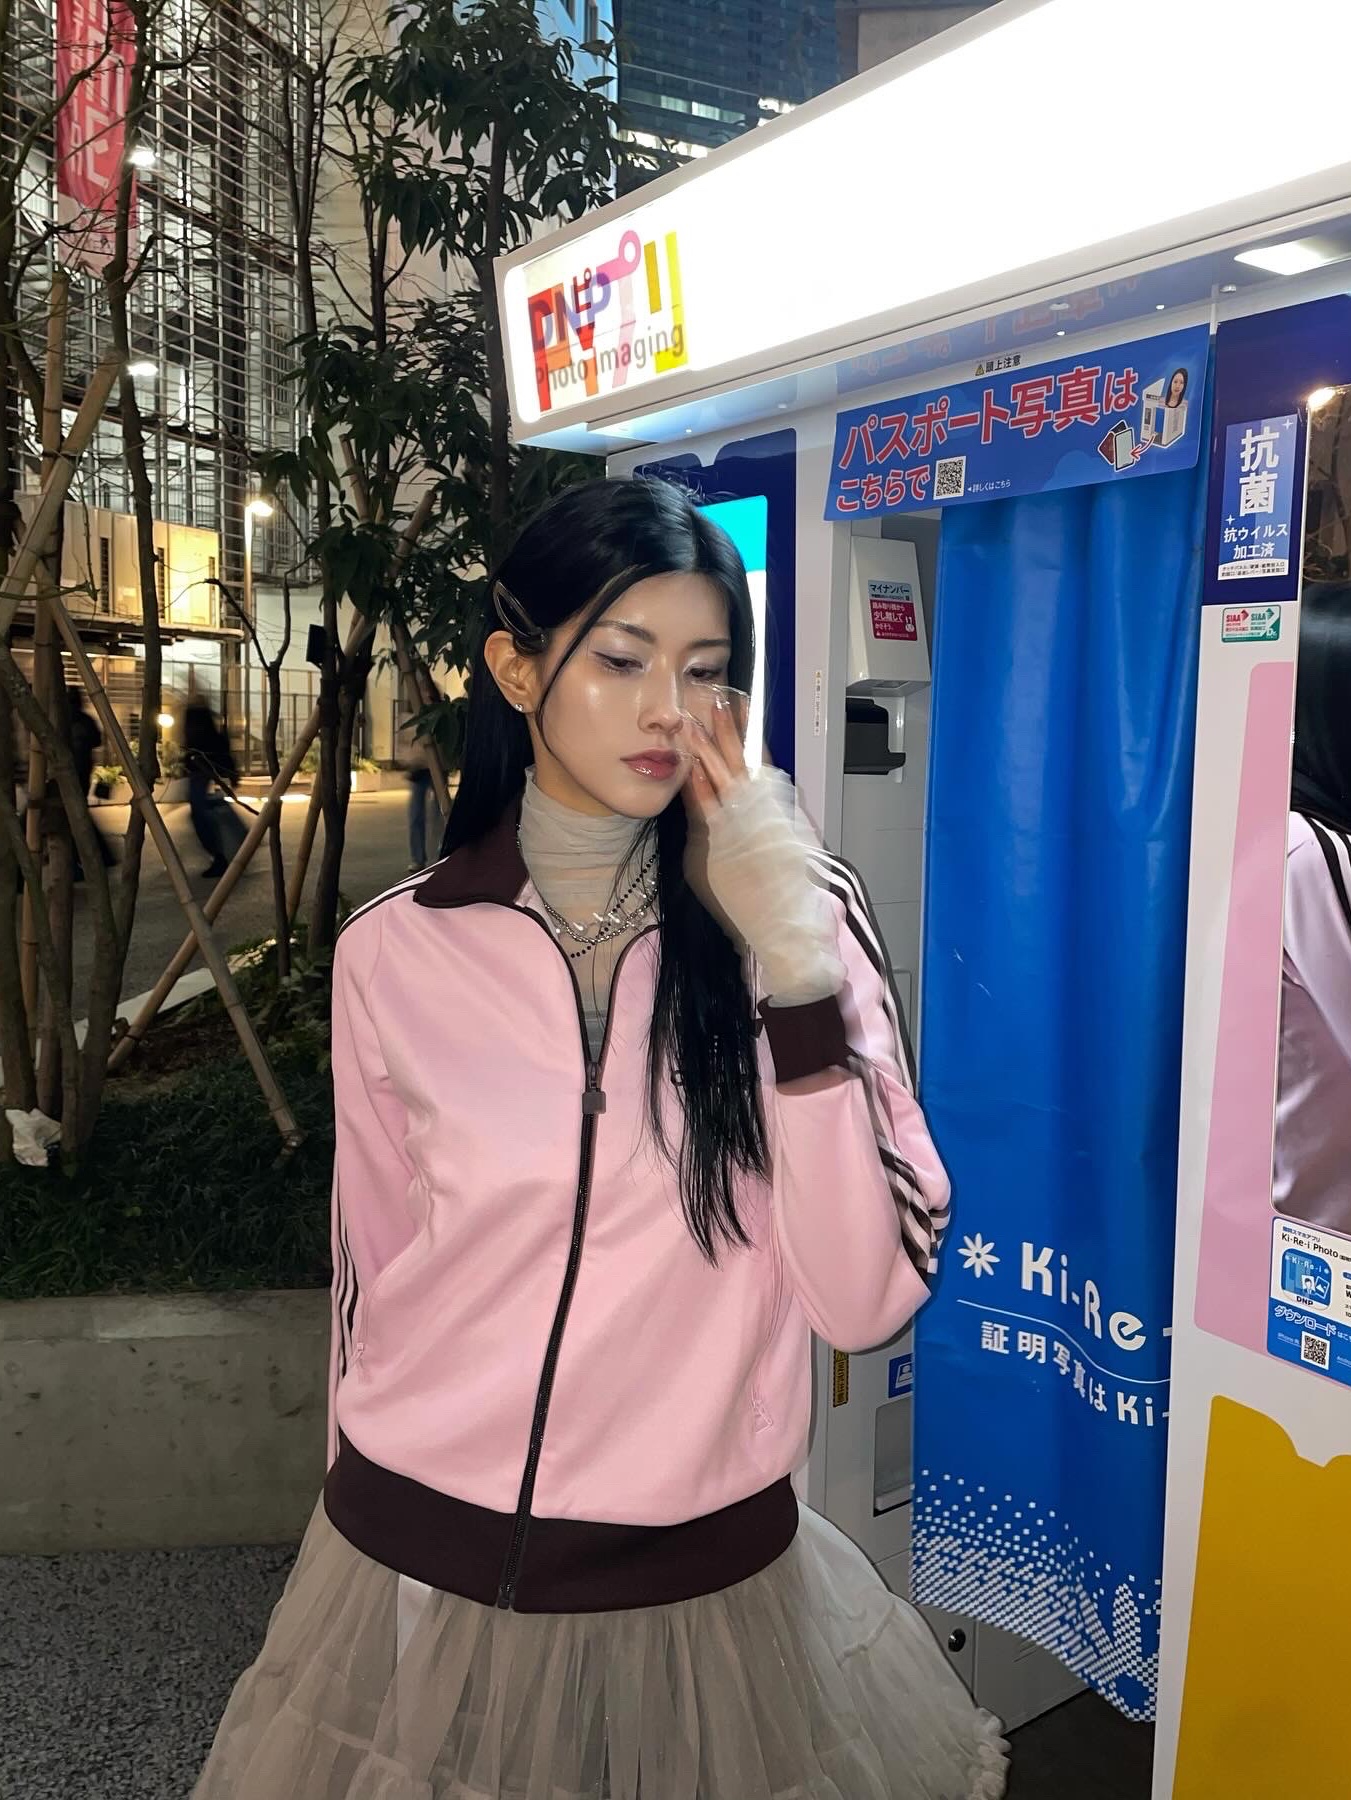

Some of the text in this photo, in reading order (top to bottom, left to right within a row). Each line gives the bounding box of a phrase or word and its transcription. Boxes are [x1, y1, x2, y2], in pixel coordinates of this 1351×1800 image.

[837, 365, 1140, 471] パスポート写真は
[1239, 426, 1280, 517] 抗菌
[835, 464, 931, 513] こちらで
[1223, 523, 1289, 543] 抗ウイルス
[1233, 542, 1276, 560] 加工済
[869, 584, 910, 594] マイナンバー
[1313, 1243, 1338, 1259] Photo
[1296, 1296, 1314, 1306] DNP
[981, 1320, 1107, 1412] 証明写真は
